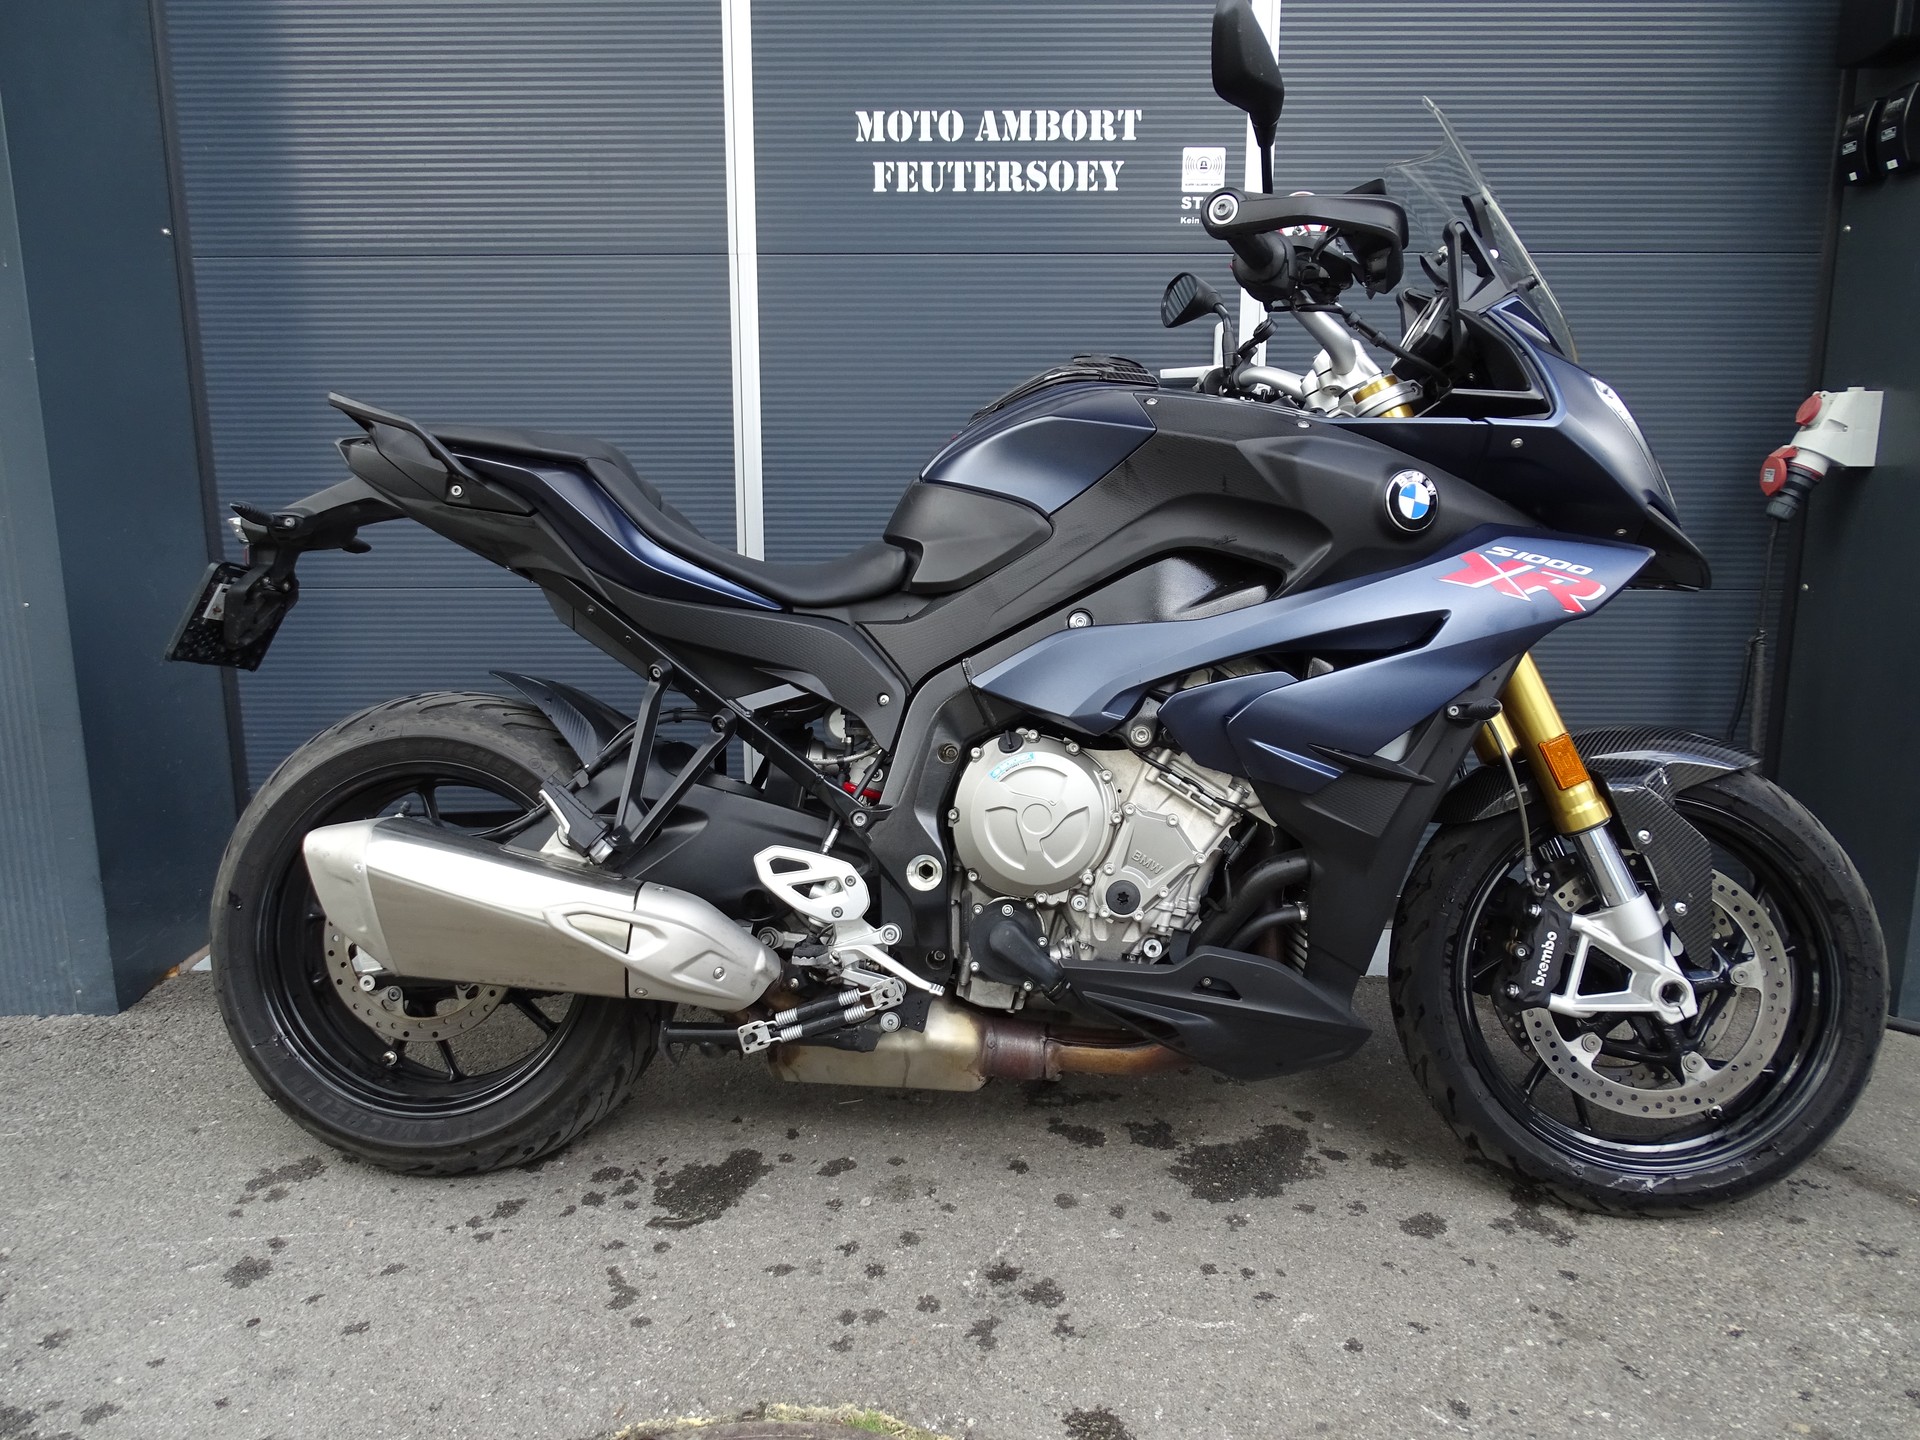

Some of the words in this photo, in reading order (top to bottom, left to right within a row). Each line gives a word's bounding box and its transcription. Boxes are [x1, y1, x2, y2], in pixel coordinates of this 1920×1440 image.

[855, 110, 965, 142] MOTO
[975, 109, 1142, 142] AMBORT
[872, 160, 1125, 193] FEUTERSOEY
[1181, 196, 1206, 210] ST
[1180, 216, 1200, 224] Kein
[1437, 551, 1606, 613] XR
[1131, 849, 1164, 875] BMW
[1531, 931, 1558, 987] brembo
